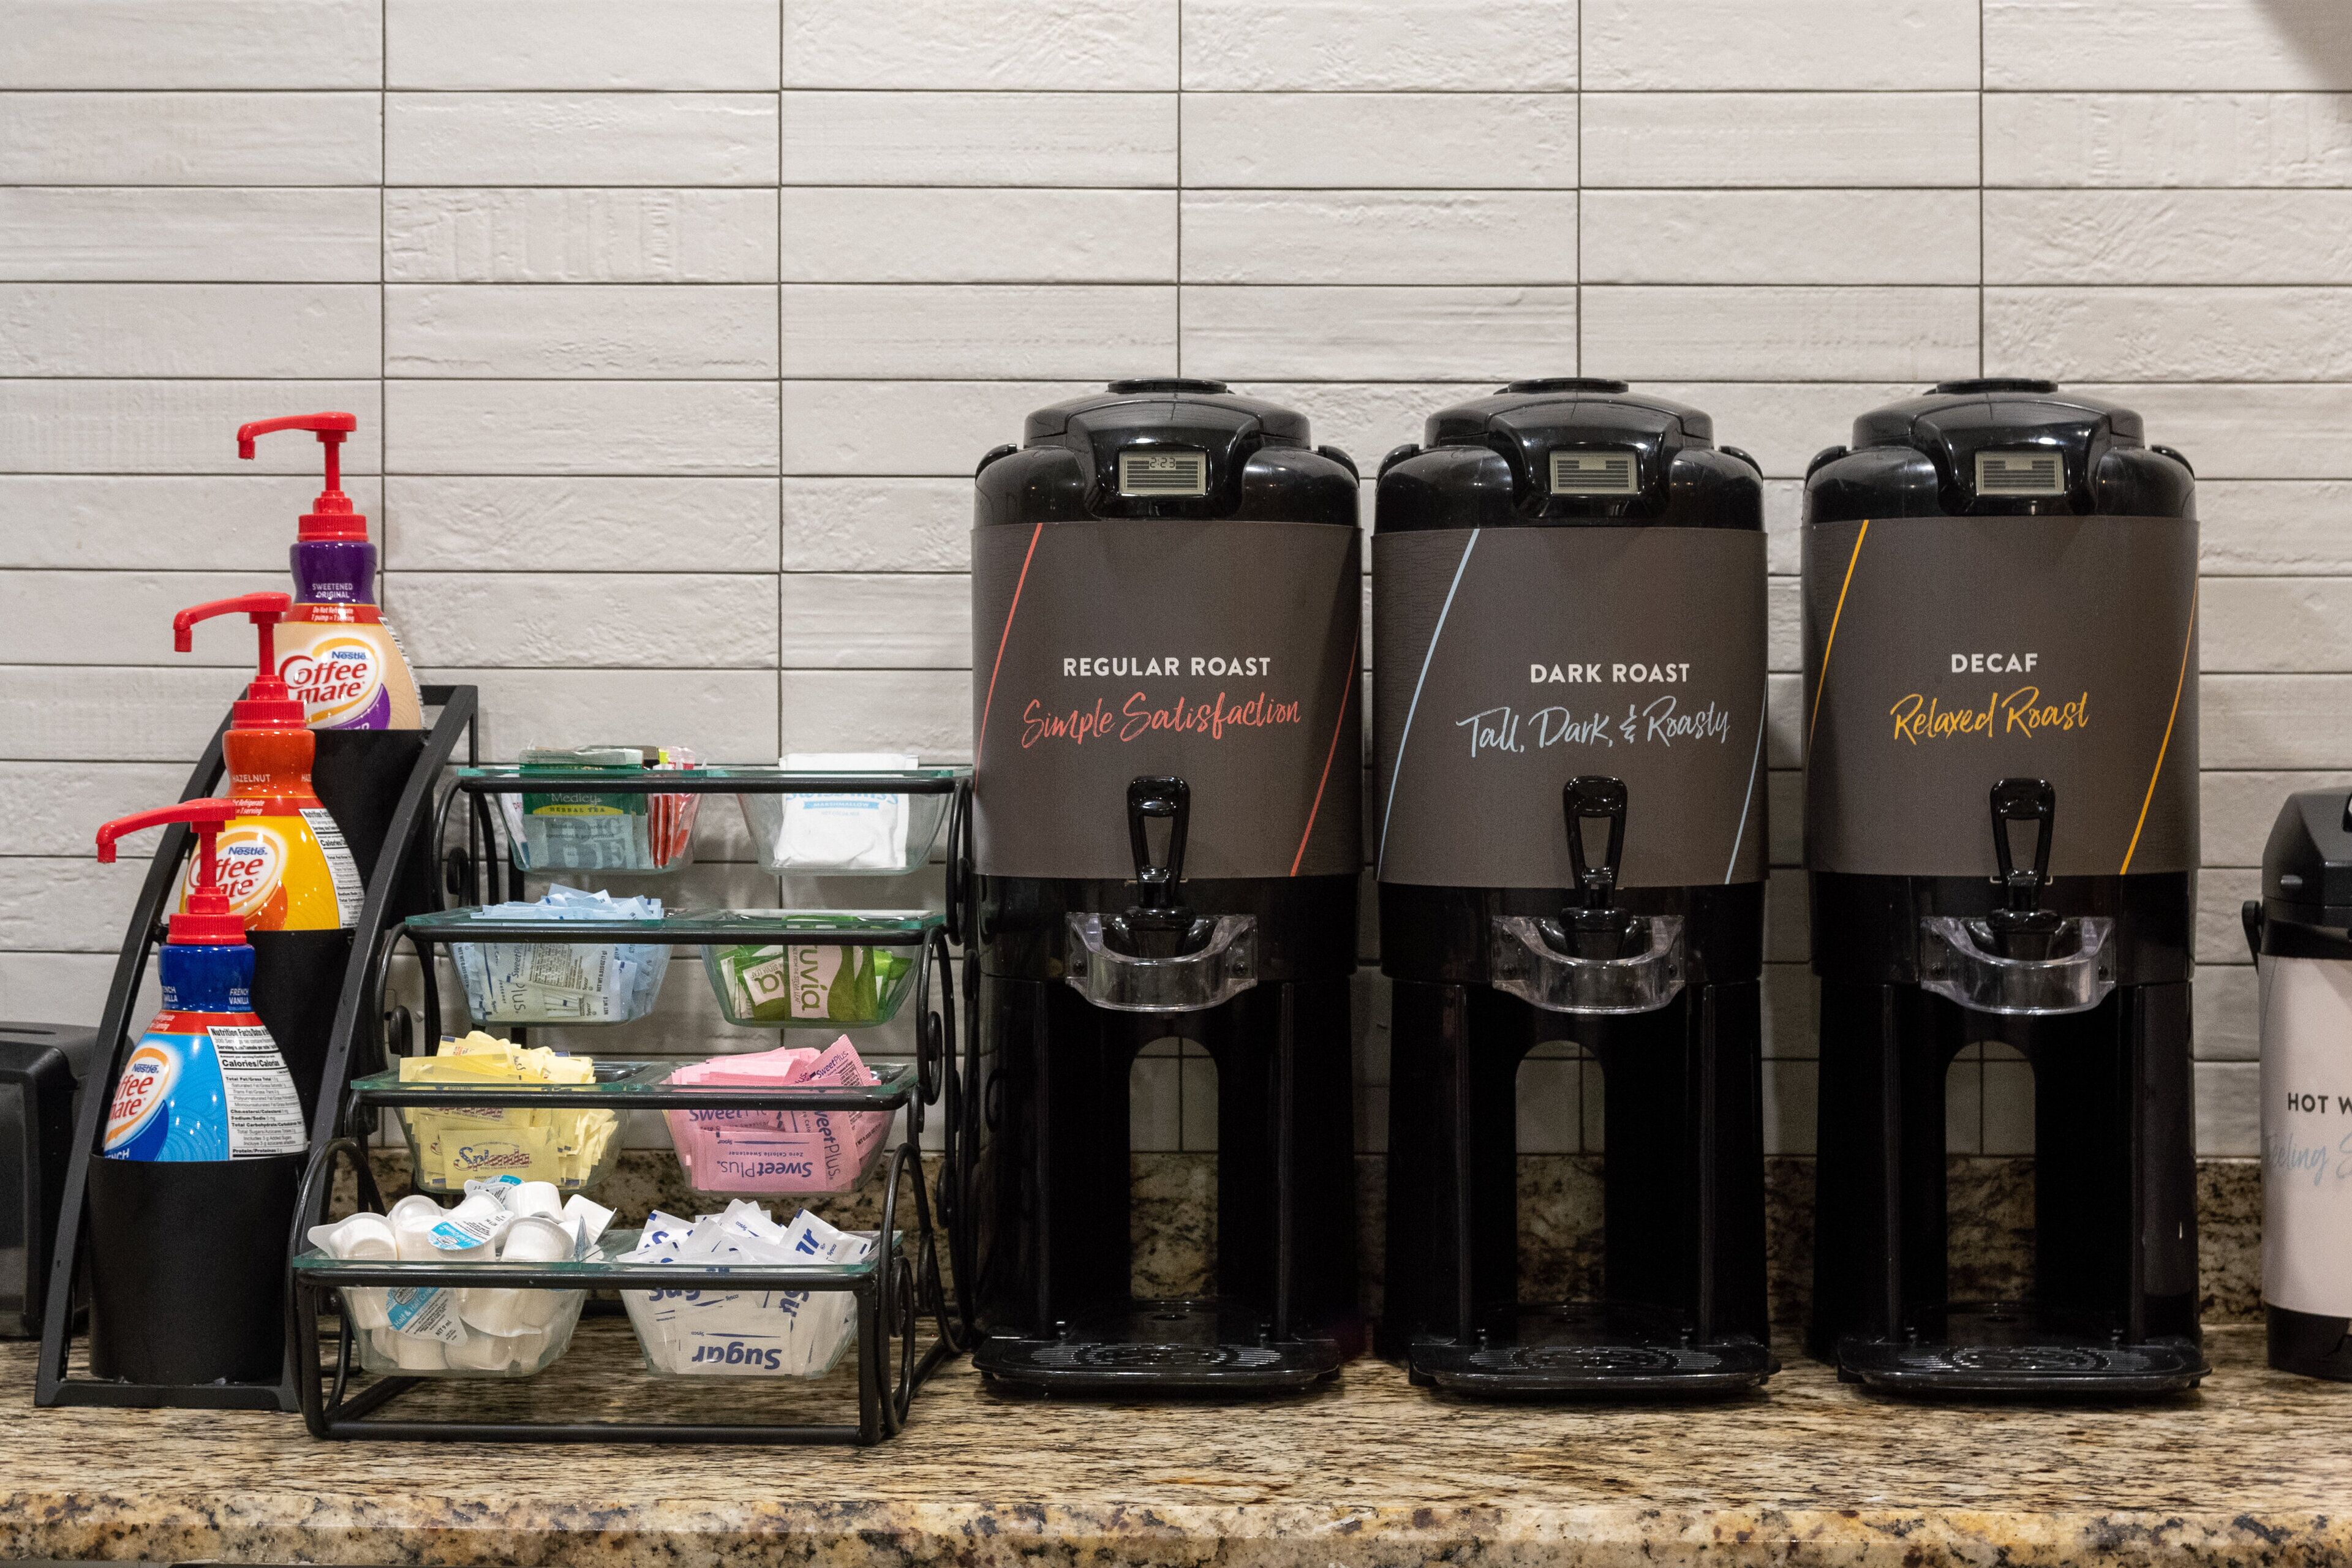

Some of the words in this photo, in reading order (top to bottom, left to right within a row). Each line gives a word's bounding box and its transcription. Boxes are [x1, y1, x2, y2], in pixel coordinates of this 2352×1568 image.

[1150, 457, 1175, 468] 2:23
[279, 655, 367, 689] Coffee
[1063, 657, 1180, 676] REGULAR
[1191, 657, 1271, 676] ROAST
[1531, 663, 1602, 683] DARK
[1612, 663, 1690, 683] ROAST
[1951, 653, 2038, 673] DECAF
[296, 682, 361, 703] mate
[1021, 698, 1116, 748] Simple
[1120, 692, 1302, 742] Satisfaction
[1890, 692, 1999, 745] Relaxed
[2001, 685, 2090, 739] Roast
[1455, 706, 1525, 758] Tall,
[1528, 705, 1614, 748] Dark,
[1619, 704, 1638, 744] &
[1643, 695, 1731, 747] Roasty
[2288, 1093, 2329, 1114] HOT
[453, 1147, 530, 1172] Splenda
[720, 1161, 813, 1178] SweetPlus
[735, 1221, 748, 1231] Sysco
[827, 1243, 837, 1256] Sysco
[692, 1341, 782, 1370] Sugar
